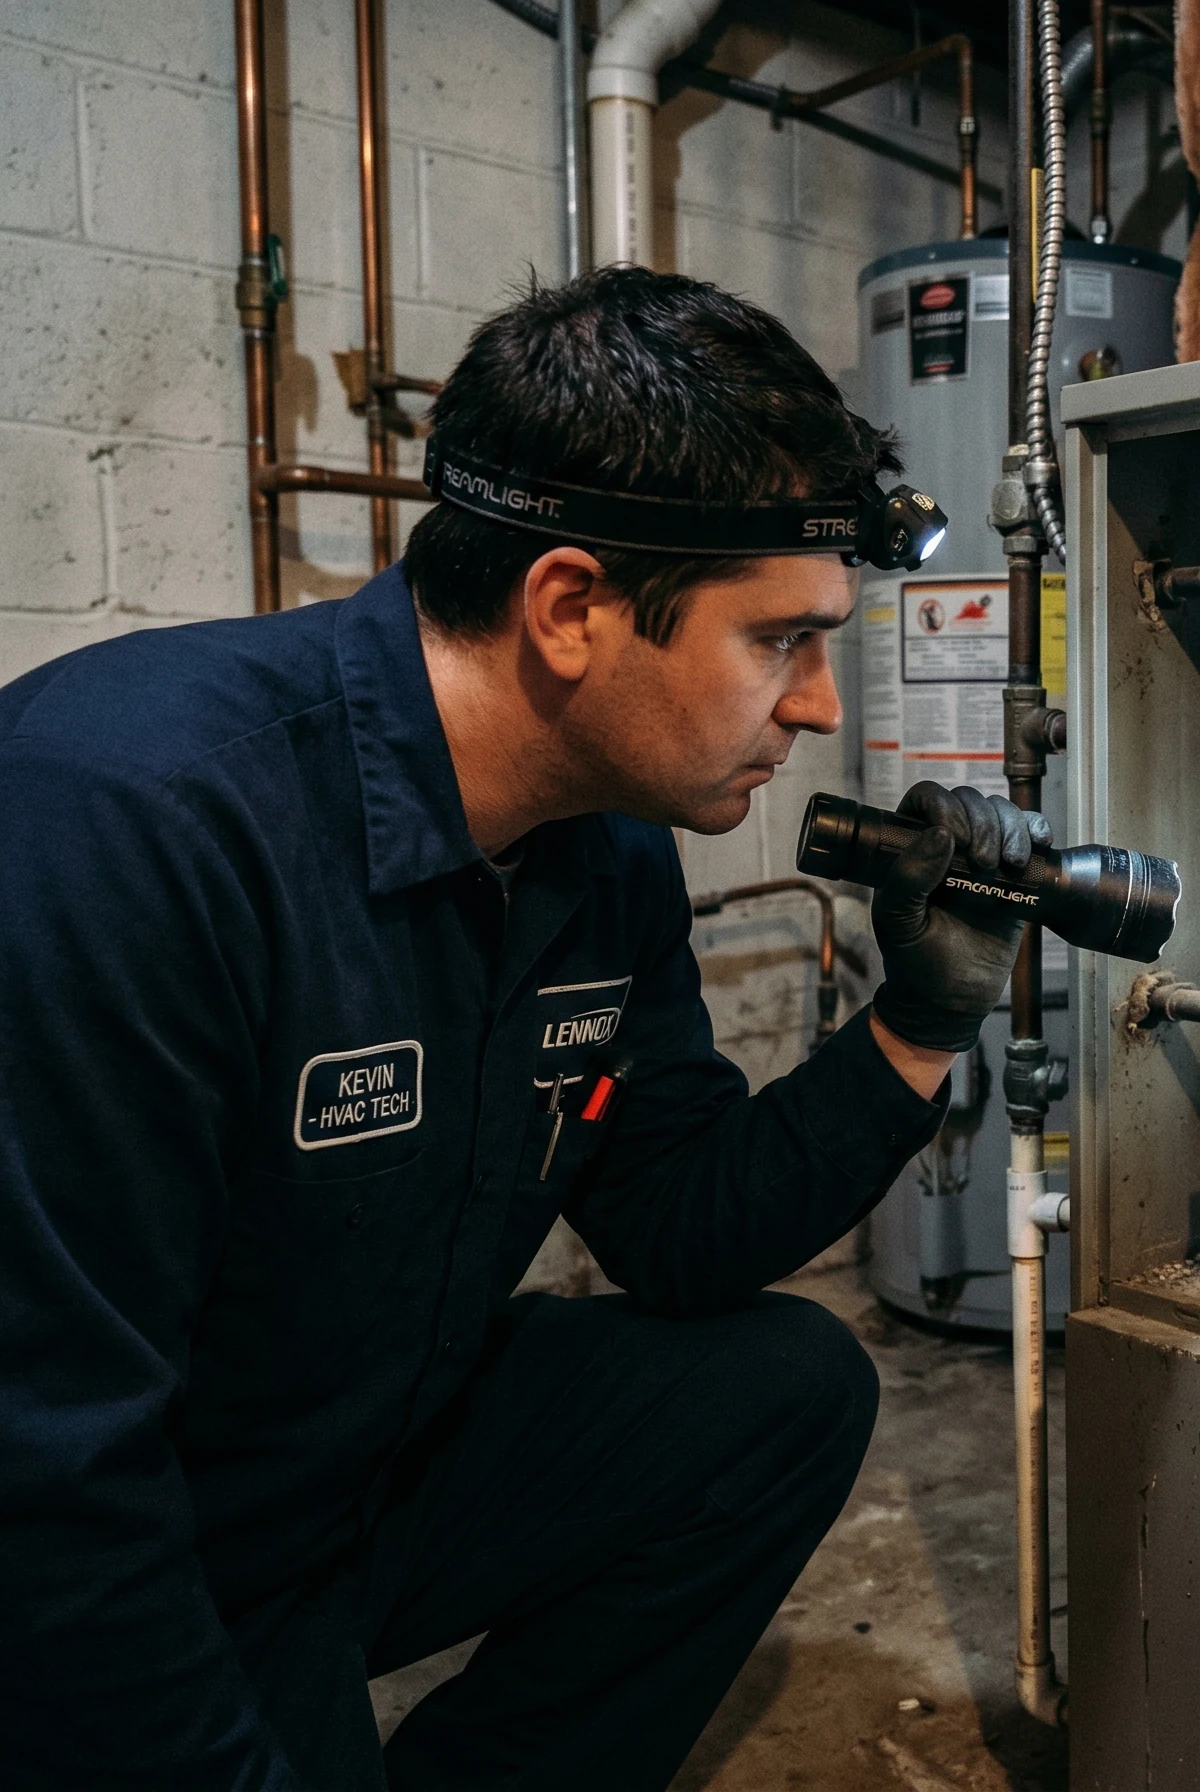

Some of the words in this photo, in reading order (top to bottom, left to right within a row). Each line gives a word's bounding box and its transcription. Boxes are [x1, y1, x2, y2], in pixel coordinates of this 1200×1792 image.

[542, 1013, 615, 1049] LENNOX
[338, 1062, 394, 1097] KEVIN
[370, 1090, 409, 1119] TECH
